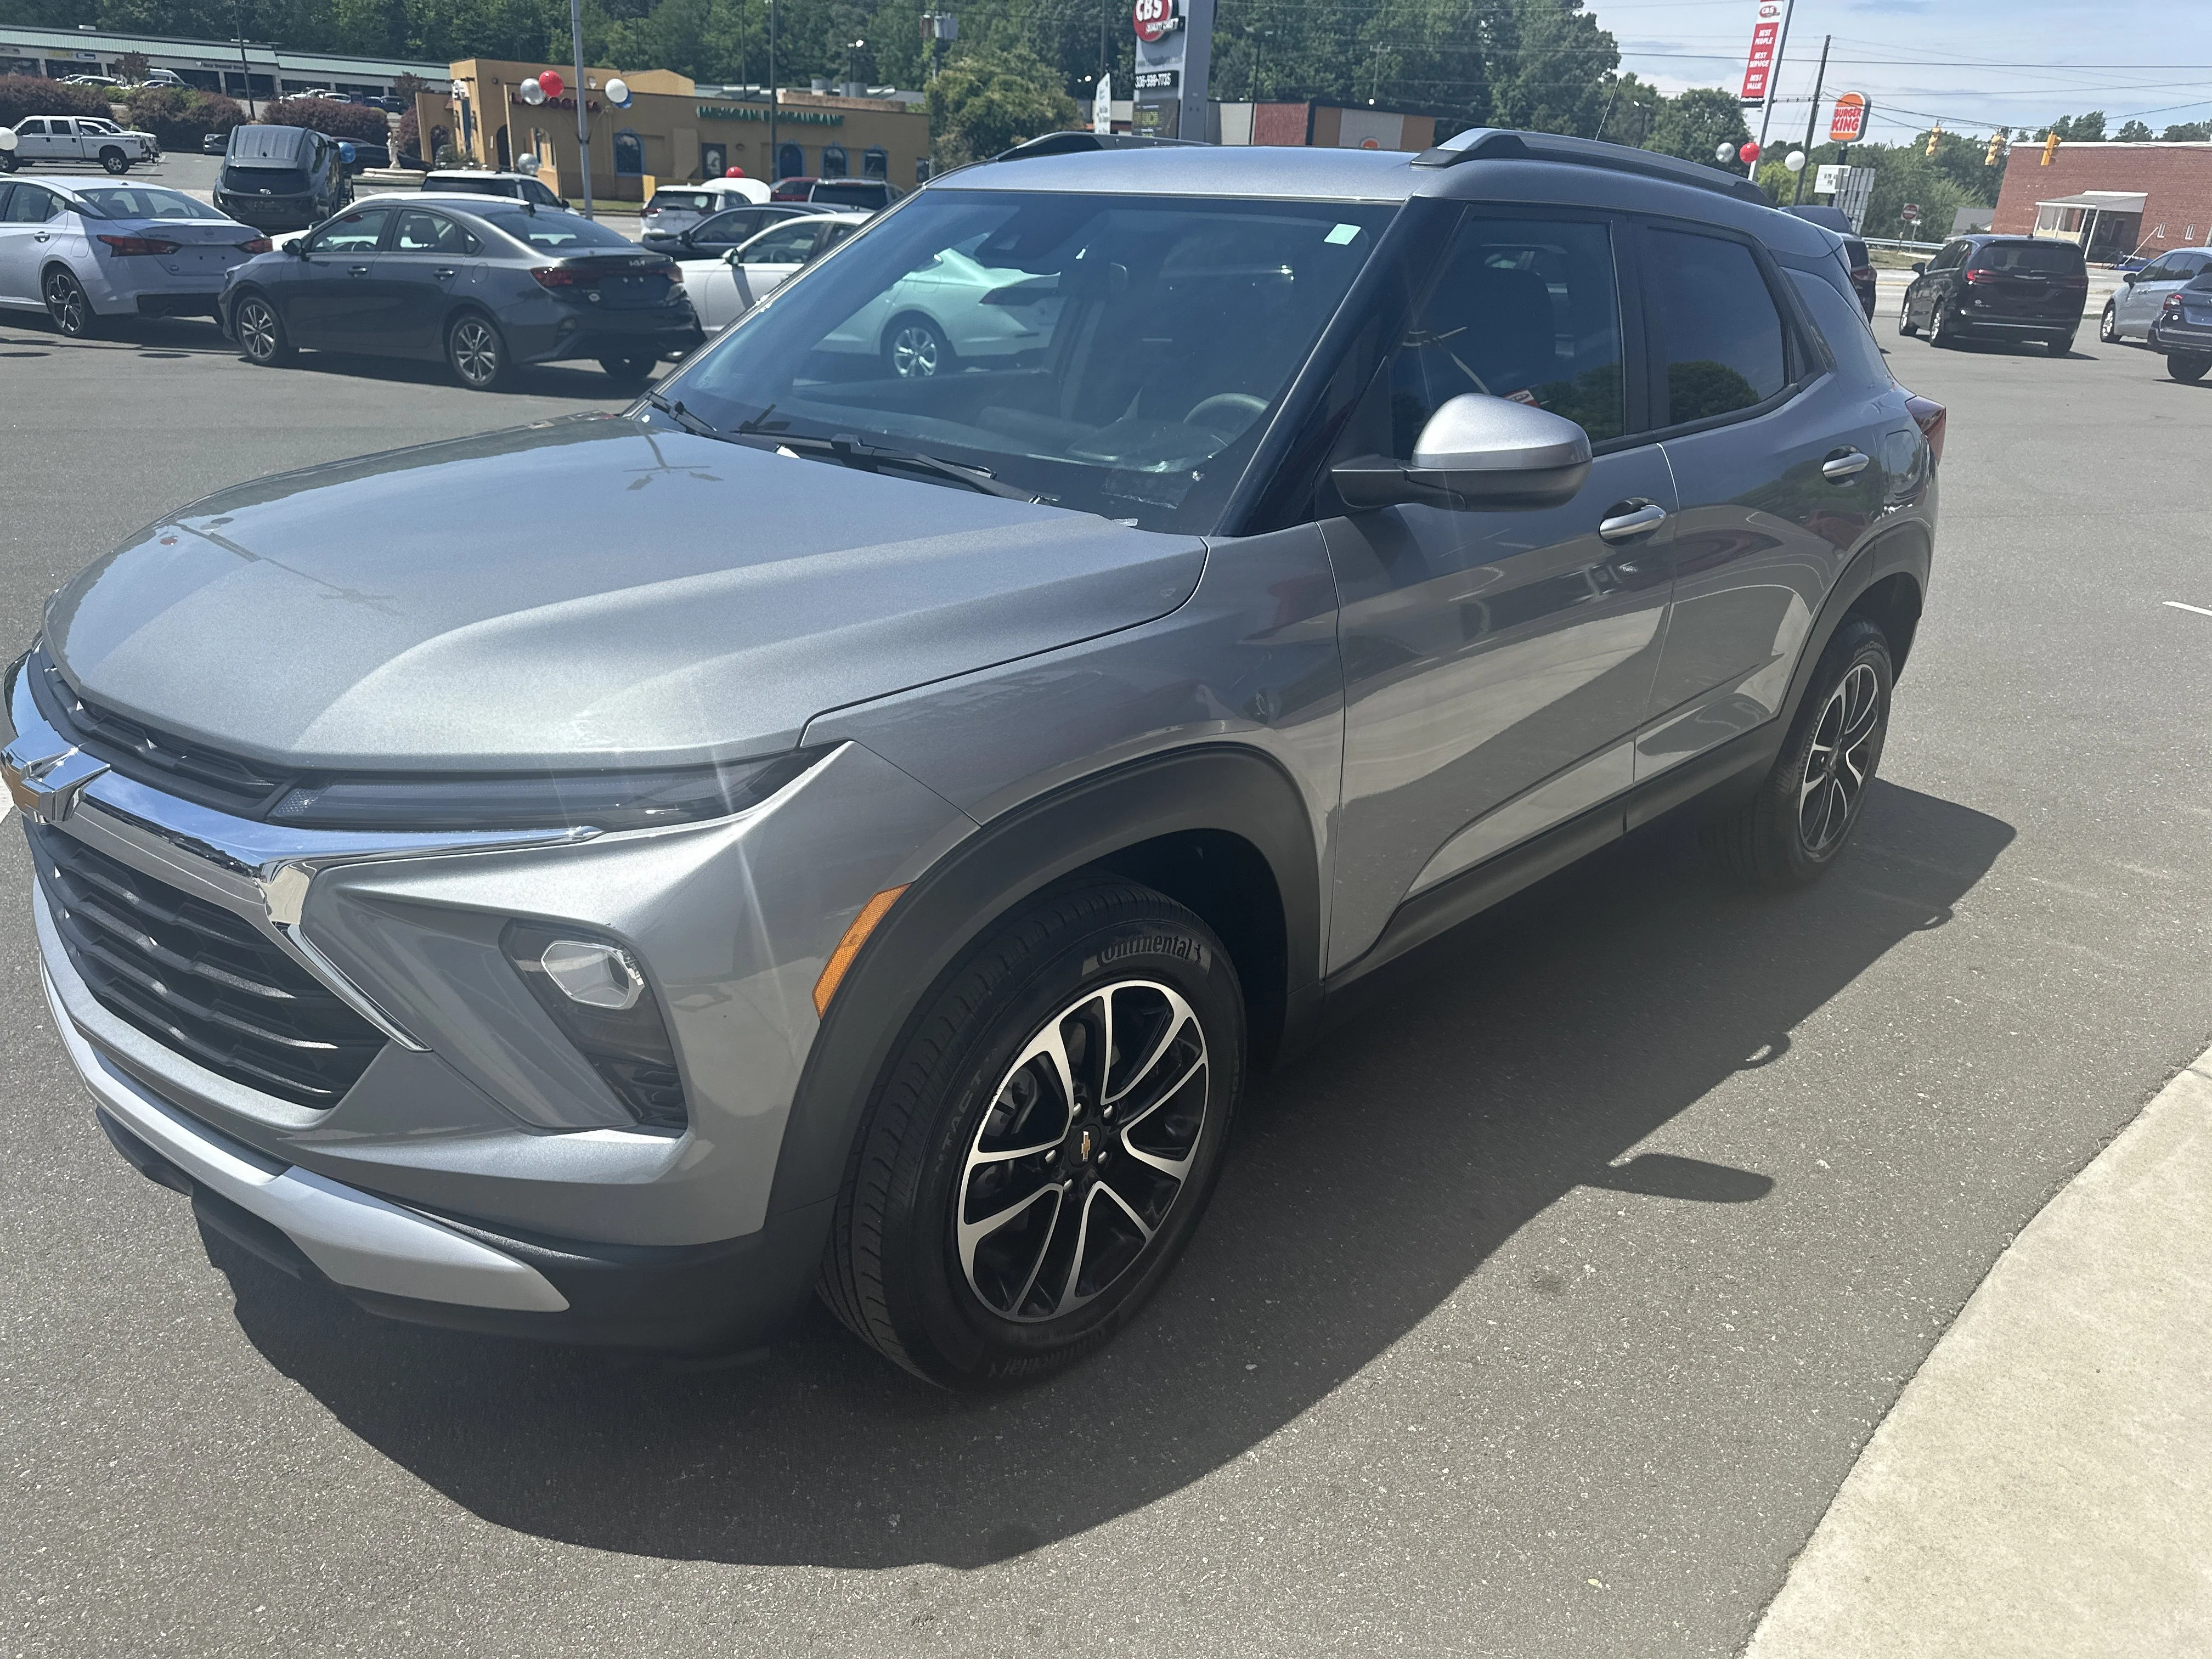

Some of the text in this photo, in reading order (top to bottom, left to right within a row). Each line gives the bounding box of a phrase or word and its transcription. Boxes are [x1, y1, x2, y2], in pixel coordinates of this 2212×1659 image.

[1136, 0, 1163, 22] CBS
[1759, 29, 1773, 37] BEST
[1749, 60, 1770, 68] SERVICE
[1750, 74, 1763, 82] BEST
[1834, 108, 1862, 118] BURGER
[1831, 118, 1859, 131] KING
[1097, 934, 1193, 967] Continental
